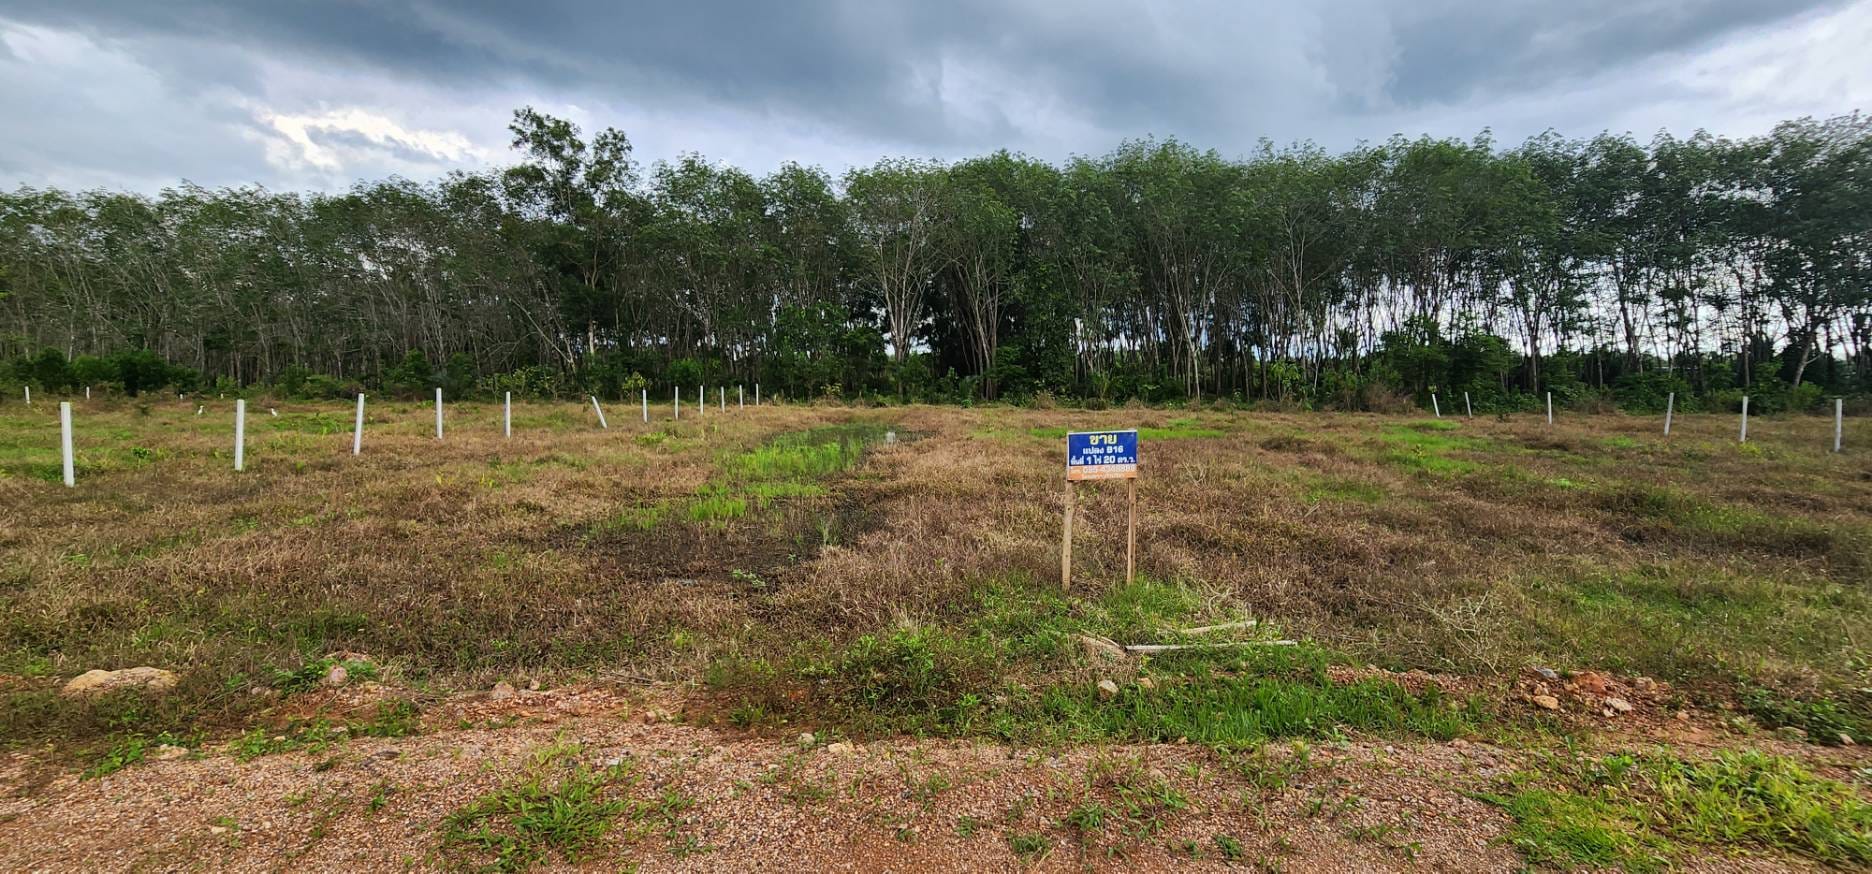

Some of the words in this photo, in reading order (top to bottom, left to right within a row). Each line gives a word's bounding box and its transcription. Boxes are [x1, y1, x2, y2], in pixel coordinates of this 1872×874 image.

[1089, 434, 1117, 445] ขาย
[1082, 446, 1104, 454] แปลง
[1106, 446, 1124, 454] B16
[1086, 456, 1092, 464] 1
[1104, 455, 1115, 464] 20
